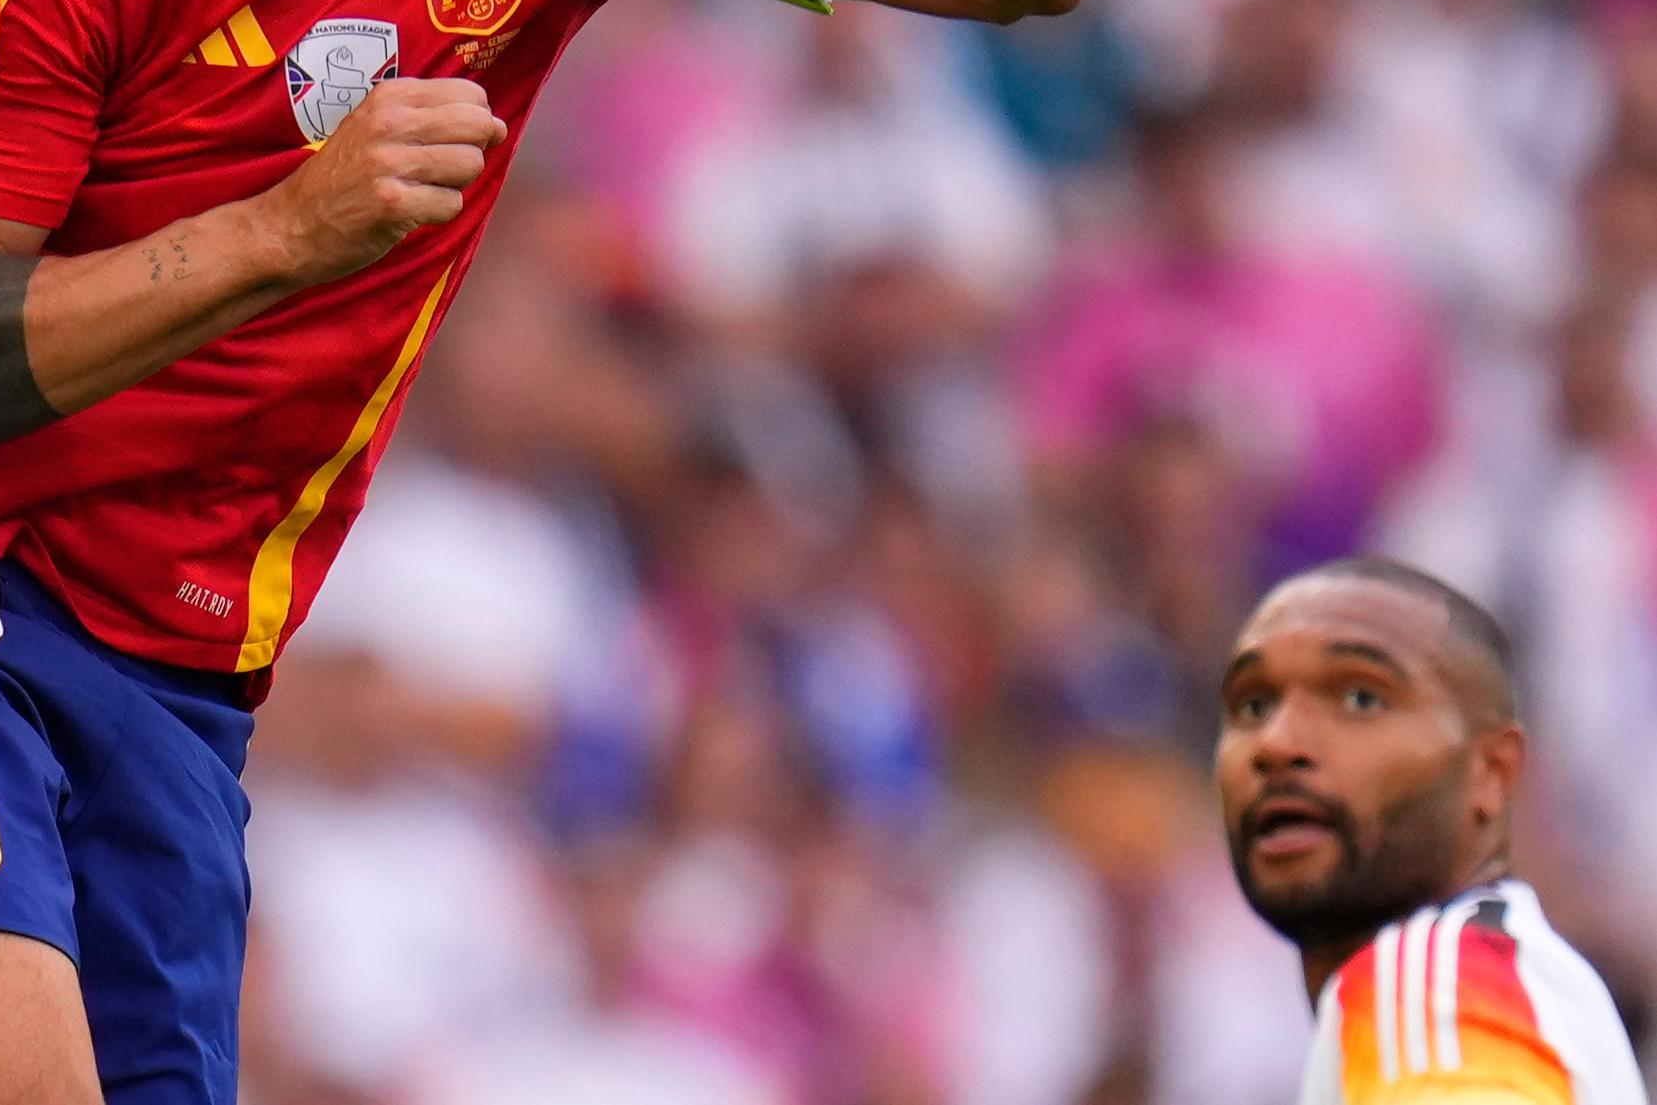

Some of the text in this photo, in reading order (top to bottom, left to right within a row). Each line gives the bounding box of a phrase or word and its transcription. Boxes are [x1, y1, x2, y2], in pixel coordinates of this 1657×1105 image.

[315, 24, 356, 34] NATIONS
[357, 24, 392, 36] LEAGUE
[175, 581, 234, 618] HEAT.RDY
